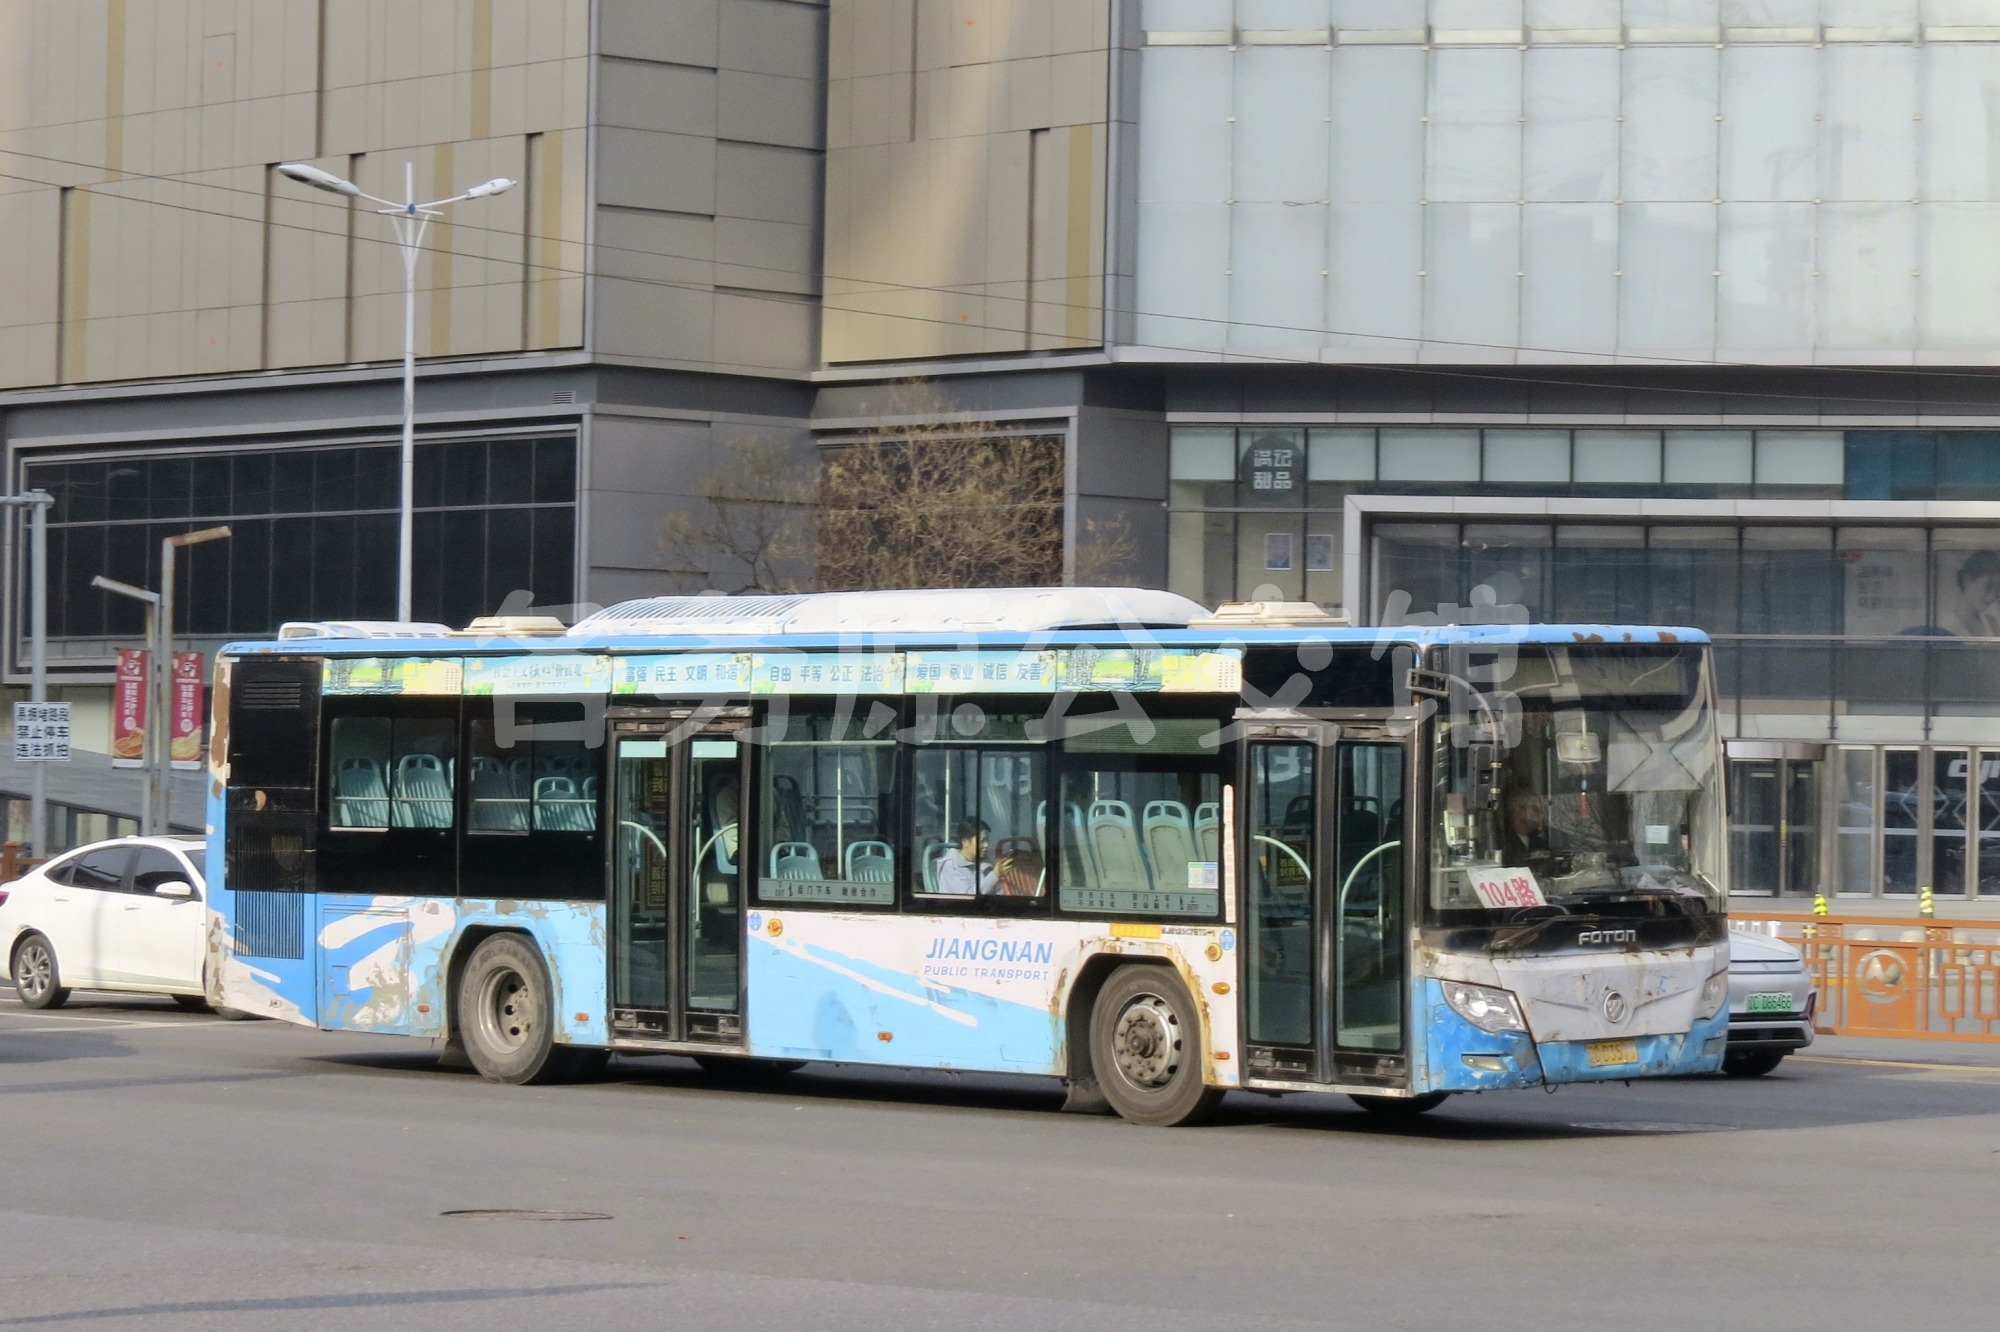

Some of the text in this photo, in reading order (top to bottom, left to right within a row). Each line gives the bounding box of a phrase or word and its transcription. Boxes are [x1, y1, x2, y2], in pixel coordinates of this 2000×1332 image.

[1254, 472, 1292, 489] 甜品
[625, 664, 738, 682] 富强 民主 文明 和谐
[770, 666, 884, 682] 自由 平等 公正 法治
[917, 663, 1041, 680] 爱国 敬业 诚信 友善
[17, 725, 69, 739] 禁止停车
[1479, 877, 1538, 907] 104路
[1578, 930, 1636, 945] FOTON
[926, 938, 1053, 963] JIANGNAN
[923, 965, 1049, 980] PUBLIC TRANSPORT
